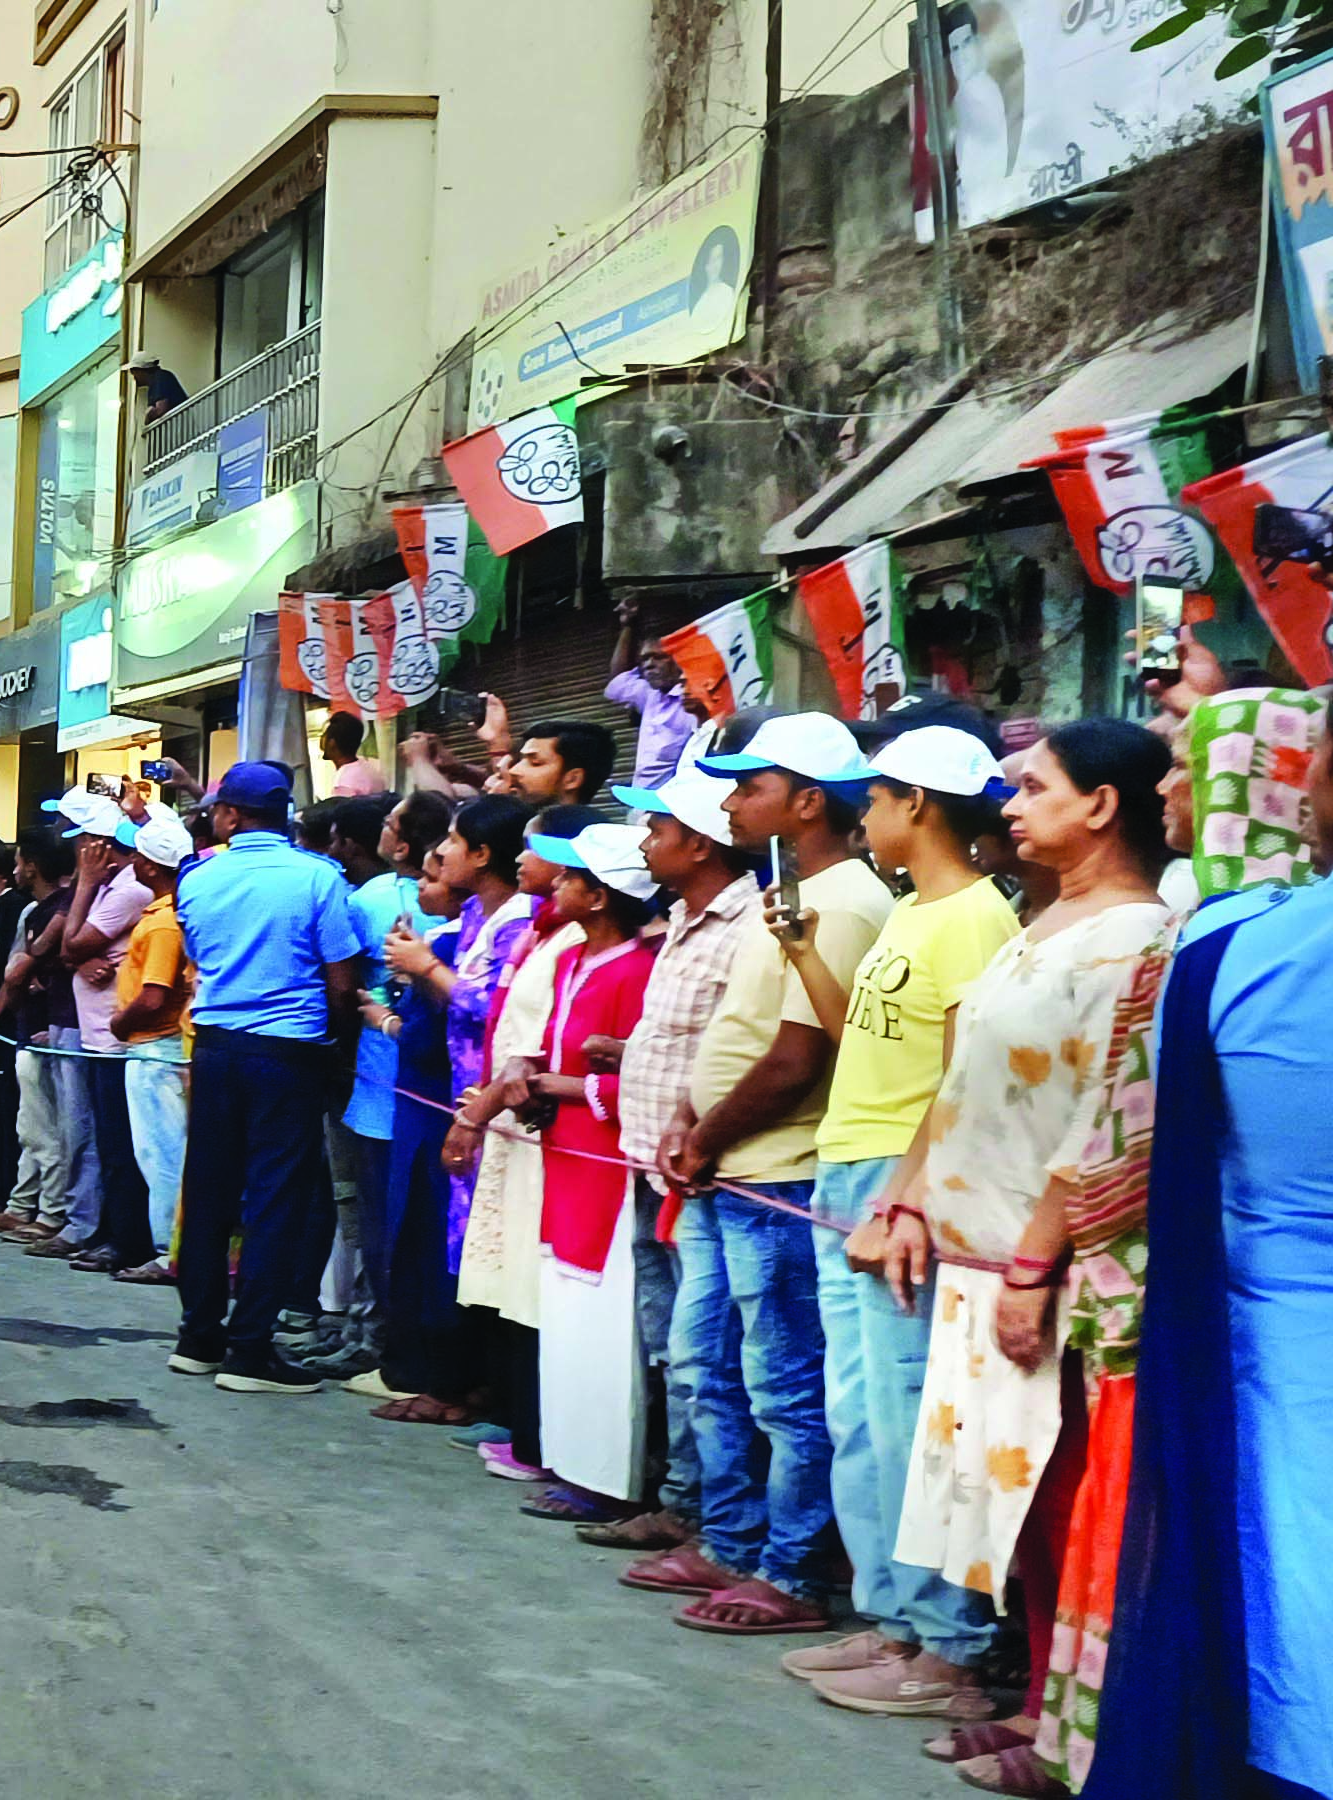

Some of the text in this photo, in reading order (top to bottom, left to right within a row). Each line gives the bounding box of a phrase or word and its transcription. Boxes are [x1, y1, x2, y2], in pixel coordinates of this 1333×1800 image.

[483, 266, 540, 320] ASMITA
[39, 477, 55, 544] VOLTAS
[434, 535, 459, 556] M
